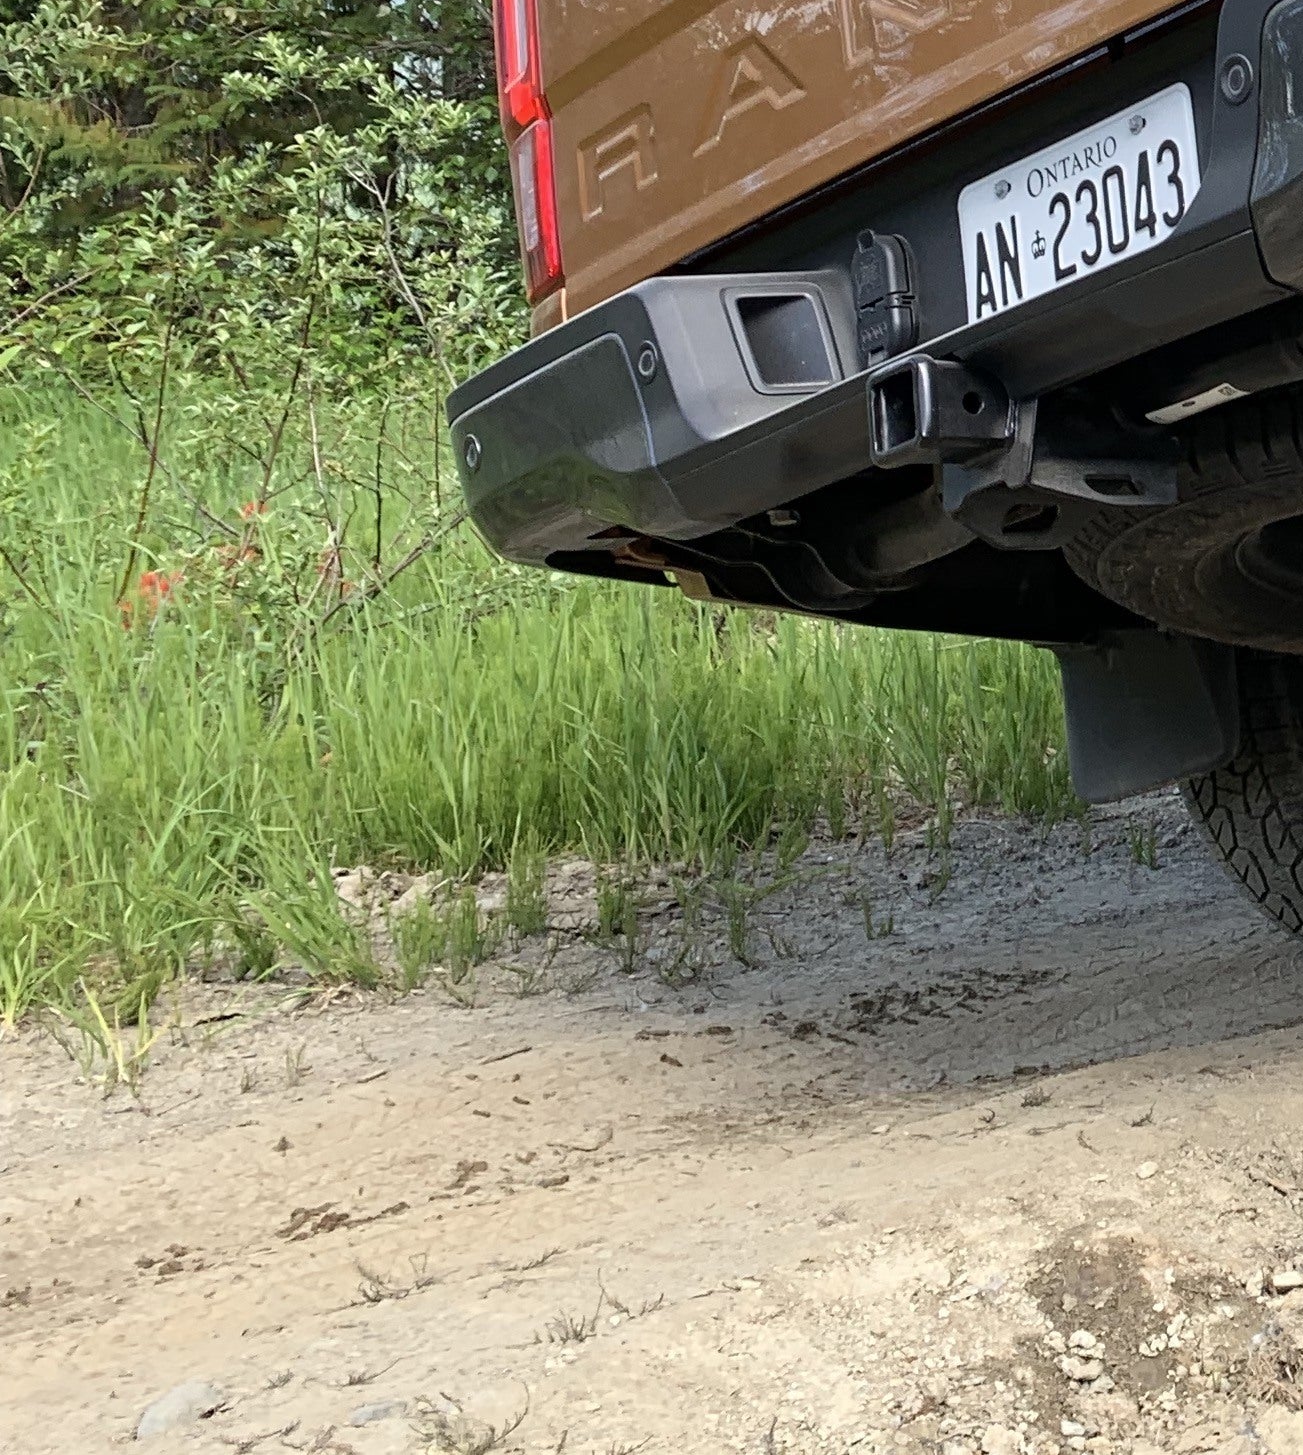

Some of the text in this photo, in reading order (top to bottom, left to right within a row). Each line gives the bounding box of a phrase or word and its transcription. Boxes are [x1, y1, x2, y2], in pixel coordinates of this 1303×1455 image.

[1026, 136, 1117, 197] ONTARIO
[976, 139, 1186, 319] AN 23043
